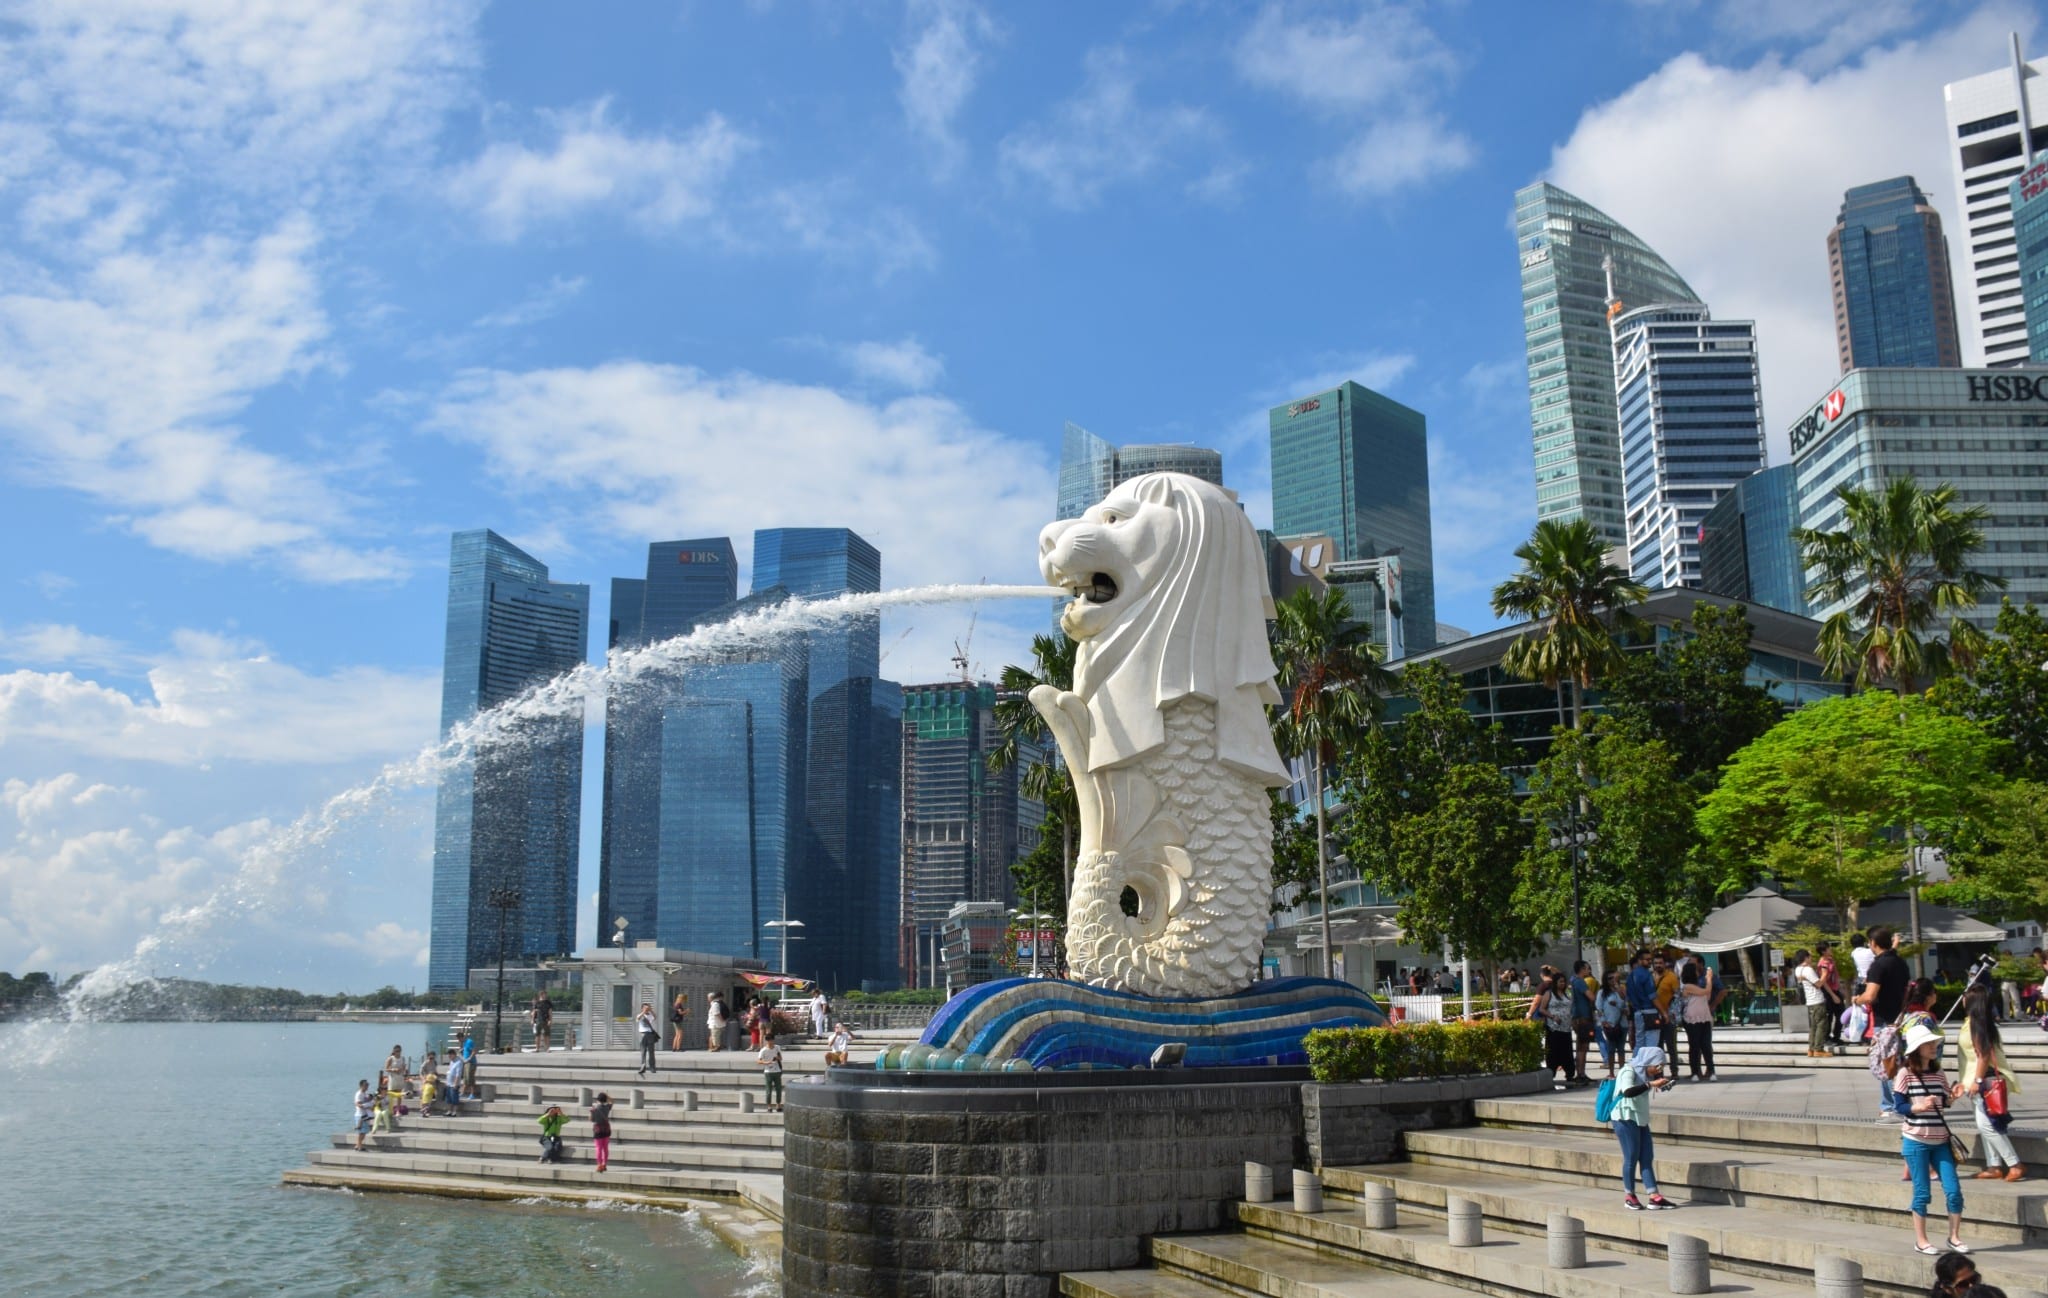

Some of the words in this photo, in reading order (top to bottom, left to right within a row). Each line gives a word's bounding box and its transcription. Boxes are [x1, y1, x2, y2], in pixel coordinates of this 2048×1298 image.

[2019, 162, 2048, 188] STR
[1966, 375, 2048, 401] HSBC
[1300, 400, 1320, 414] UBS
[1789, 404, 1825, 456] HSBC
[691, 551, 720, 563] DBS
